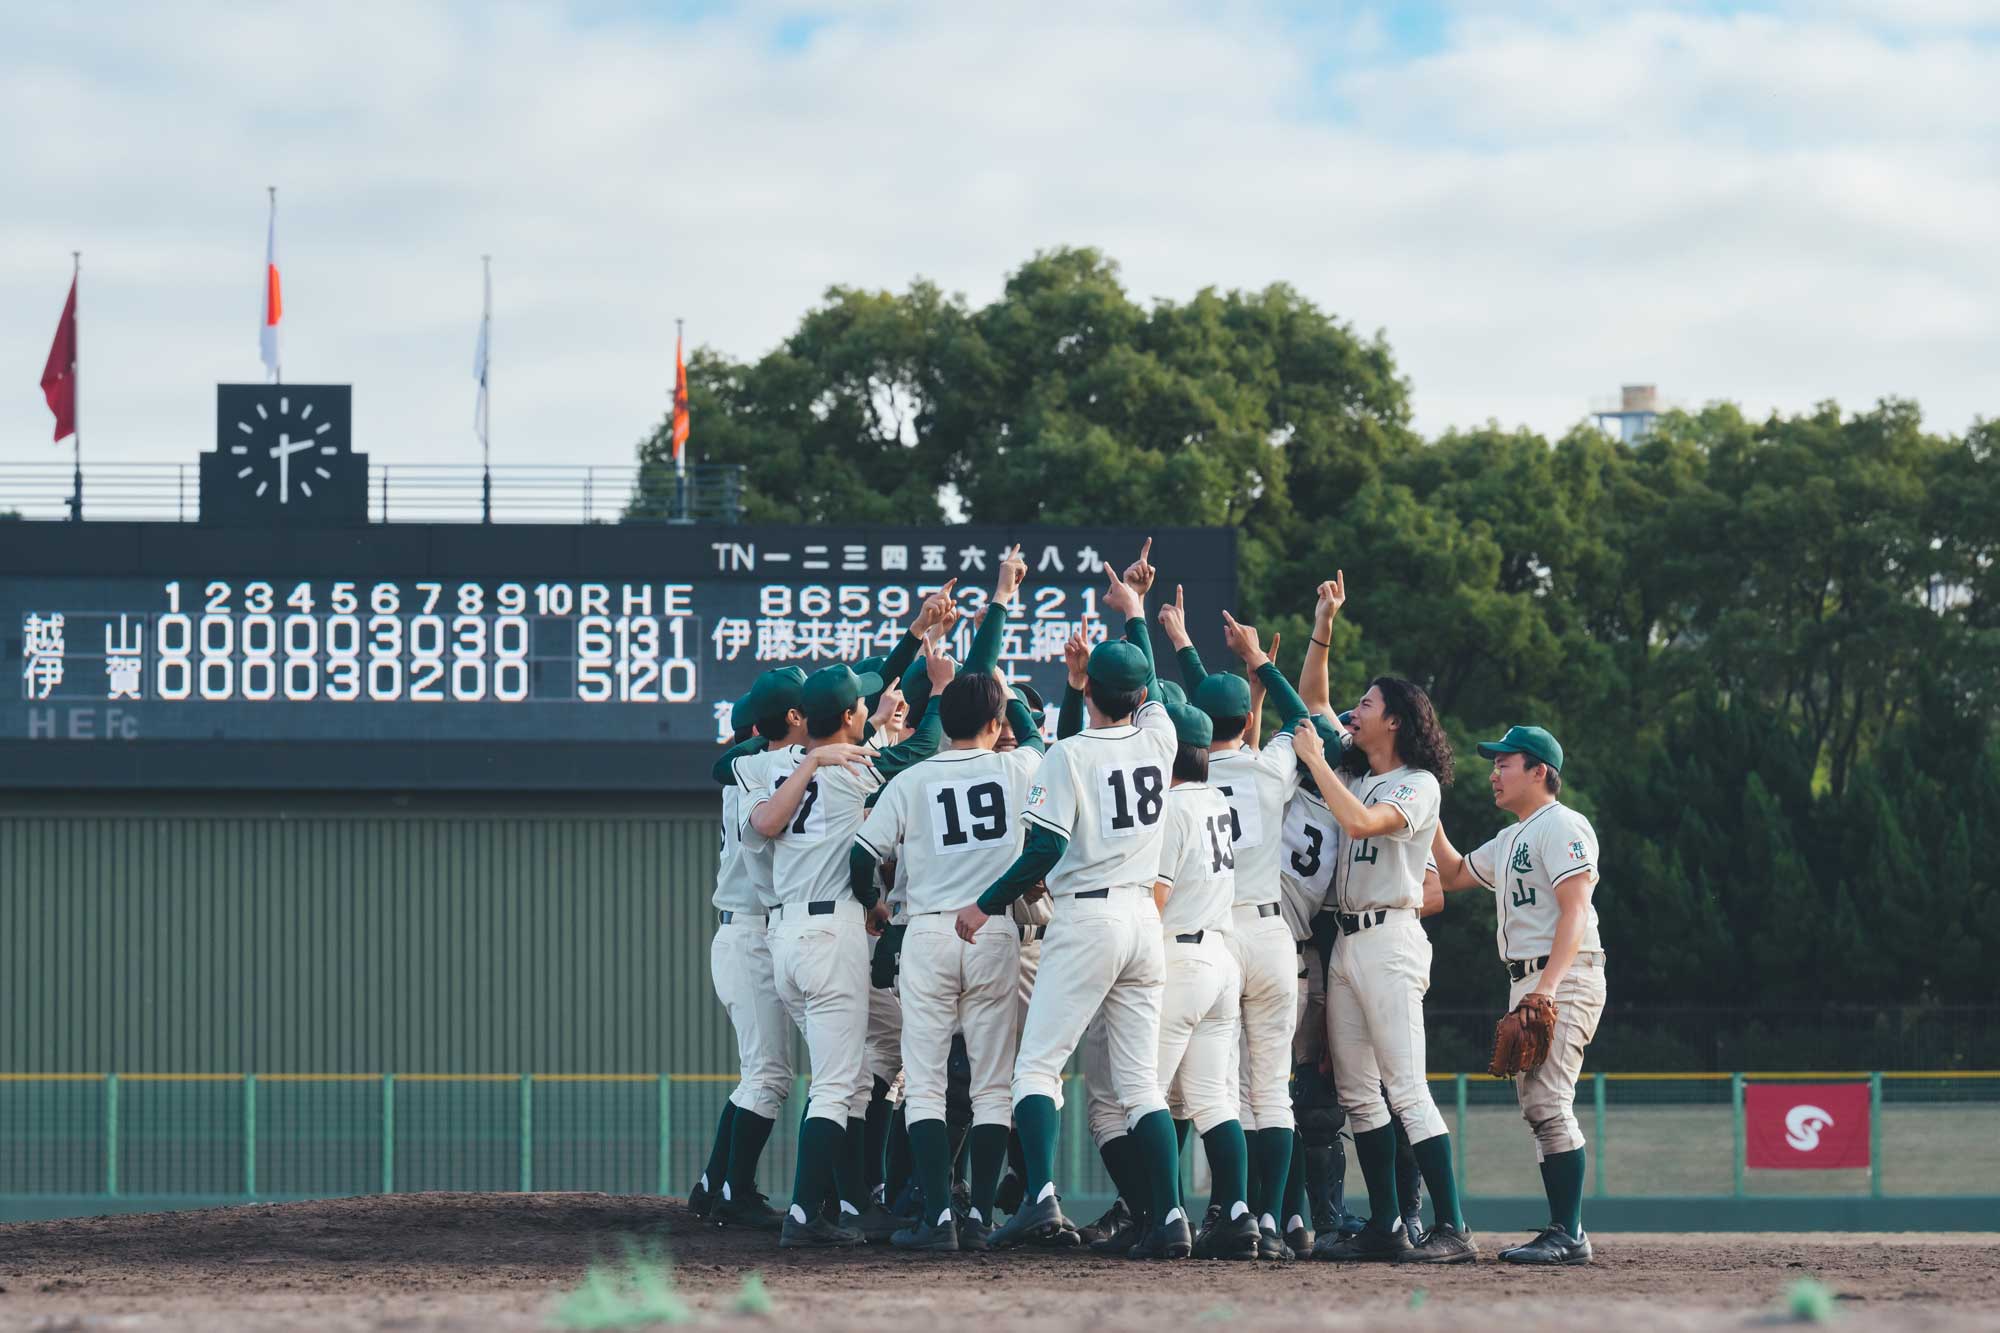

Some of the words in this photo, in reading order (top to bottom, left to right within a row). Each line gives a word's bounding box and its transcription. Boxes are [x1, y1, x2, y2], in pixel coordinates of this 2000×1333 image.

[712, 543, 755, 571] TN
[804, 546, 830, 569] 二
[843, 546, 868, 570] 三
[881, 545, 908, 571] 四
[921, 545, 947, 571] 五
[960, 545, 986, 571] 六
[1038, 546, 1064, 571] 八
[1078, 546, 1103, 572] 九
[166, 582, 180, 614] 1
[205, 582, 232, 614] 2
[245, 582, 274, 614] 3
[287, 582, 315, 614] 4
[331, 583, 358, 614] 5
[371, 583, 400, 615] 6
[416, 584, 442, 615] 7
[457, 584, 484, 615] 8
[497, 584, 526, 615] 9
[535, 584, 573, 615] 10
[581, 584, 610, 616] R
[623, 584, 652, 616] H
[665, 585, 693, 616] E
[800, 586, 831, 617] 6
[839, 586, 870, 617] 5
[878, 586, 909, 617] 9
[1035, 587, 1066, 618] 2
[1081, 588, 1100, 618] 1
[157, 614, 191, 657] 0
[200, 614, 233, 657] 0
[242, 614, 275, 657] 0
[284, 614, 318, 657] 0
[326, 614, 360, 657] 0
[369, 614, 402, 657] 3
[410, 614, 444, 657] 0
[452, 614, 486, 657] 3
[494, 614, 528, 657] 0
[578, 616, 612, 658] 6
[615, 616, 659, 658] 13
[669, 617, 684, 658] 1
[157, 657, 191, 701] 0
[200, 657, 233, 701] 0
[242, 657, 275, 701] 0
[284, 657, 318, 701] 0
[326, 657, 360, 701] 3
[369, 657, 402, 701] 0
[410, 657, 444, 701] 2
[452, 657, 486, 701] 0
[494, 657, 528, 701] 0
[578, 658, 612, 702] 5
[615, 658, 659, 702] 12
[662, 658, 696, 702] 0
[29, 709, 55, 738] H
[69, 709, 94, 738] E
[937, 781, 1007, 846] 19
[1108, 766, 1164, 829] 18
[1291, 823, 1323, 877] 3
